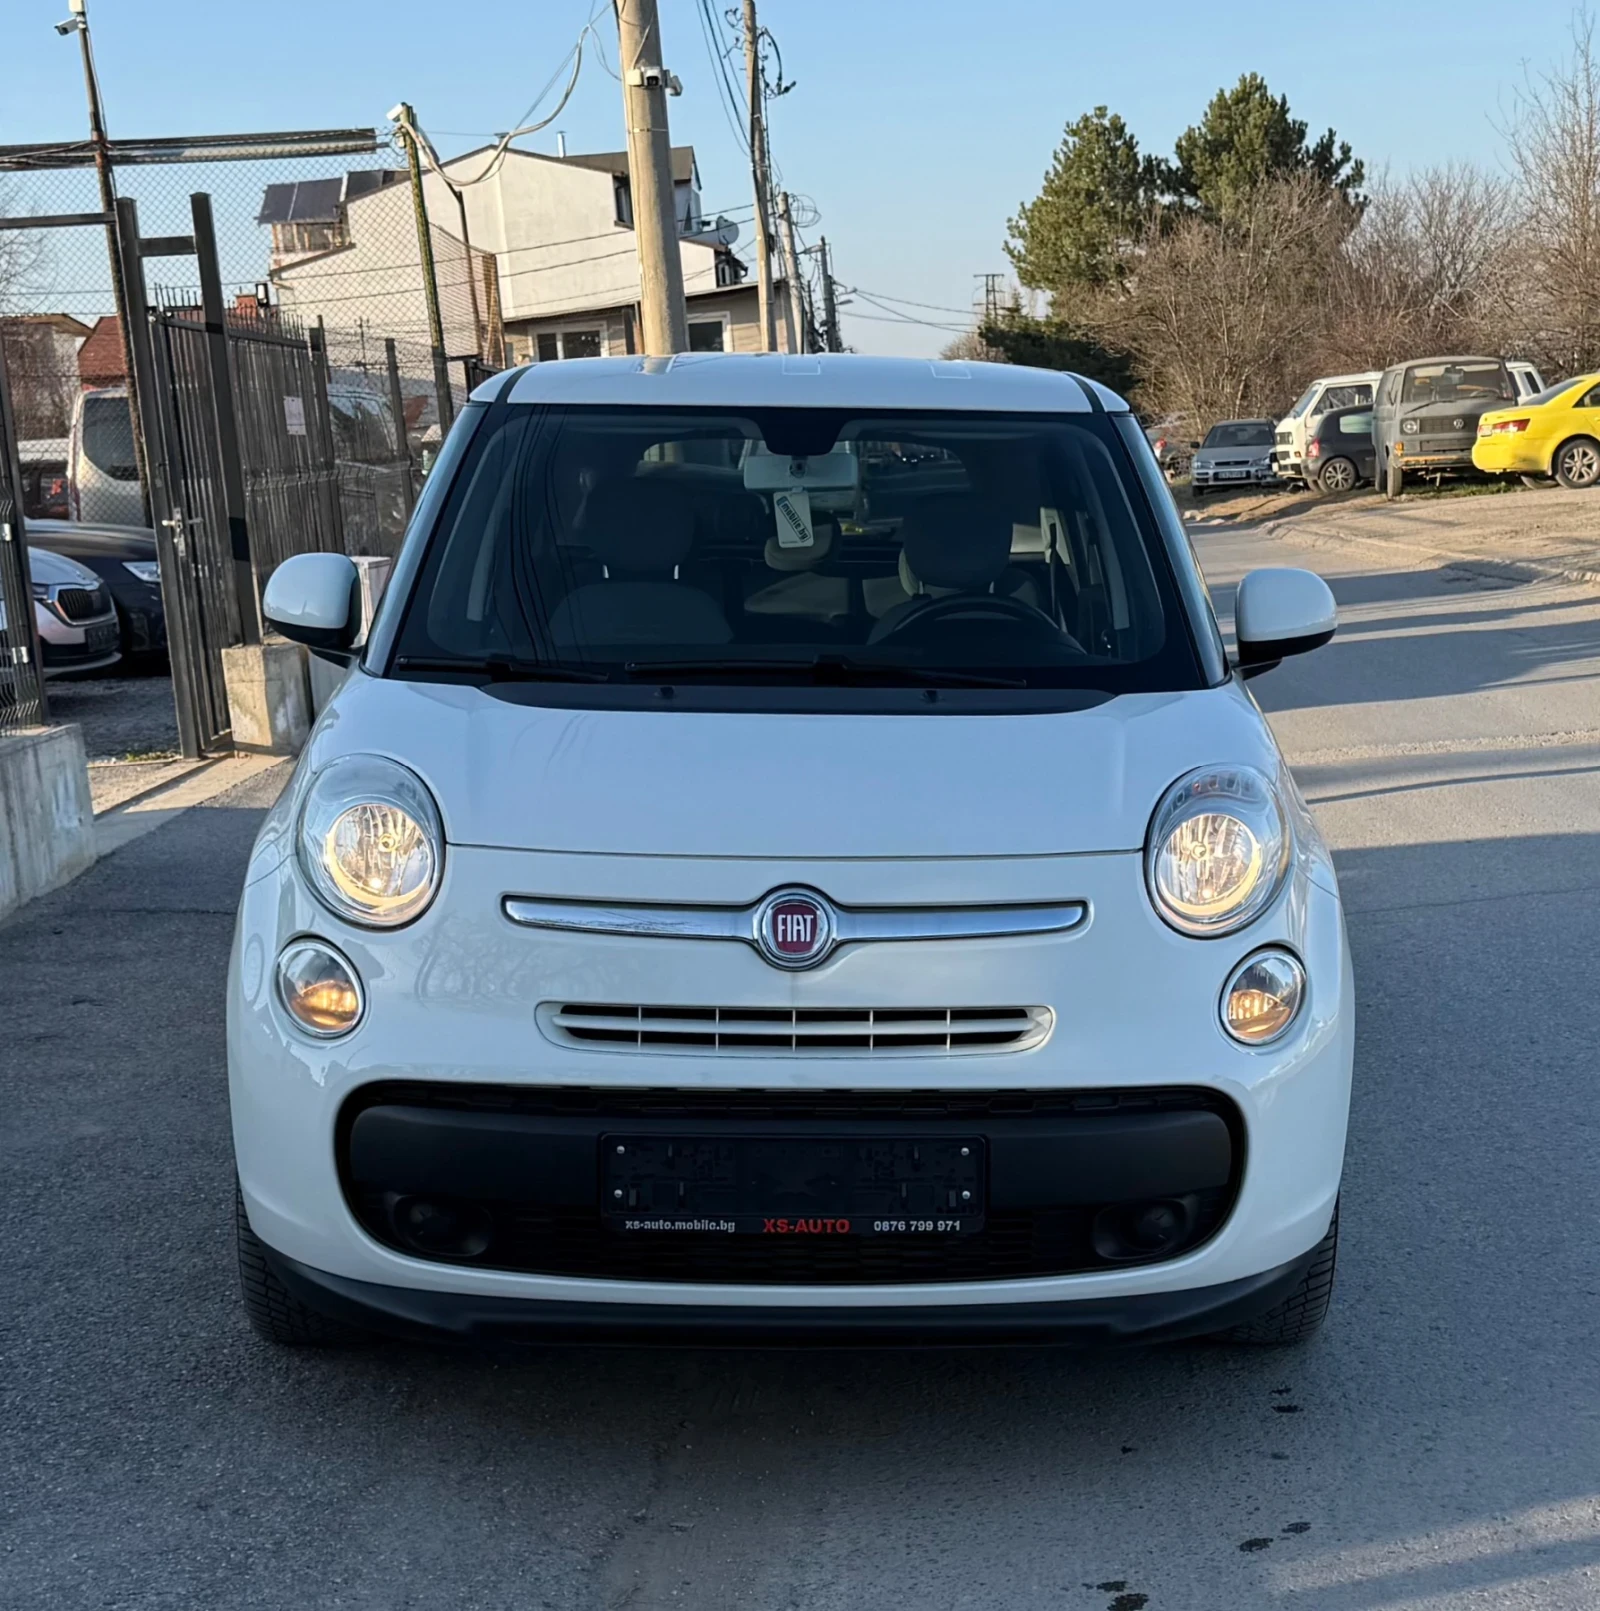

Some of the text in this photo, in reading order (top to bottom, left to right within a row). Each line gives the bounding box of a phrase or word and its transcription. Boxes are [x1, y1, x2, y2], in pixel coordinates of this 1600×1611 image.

[777, 914, 814, 942] FIAT
[625, 1218, 960, 1233] xs-auto.mobile.bg XS-AUTO 0876 799 971
